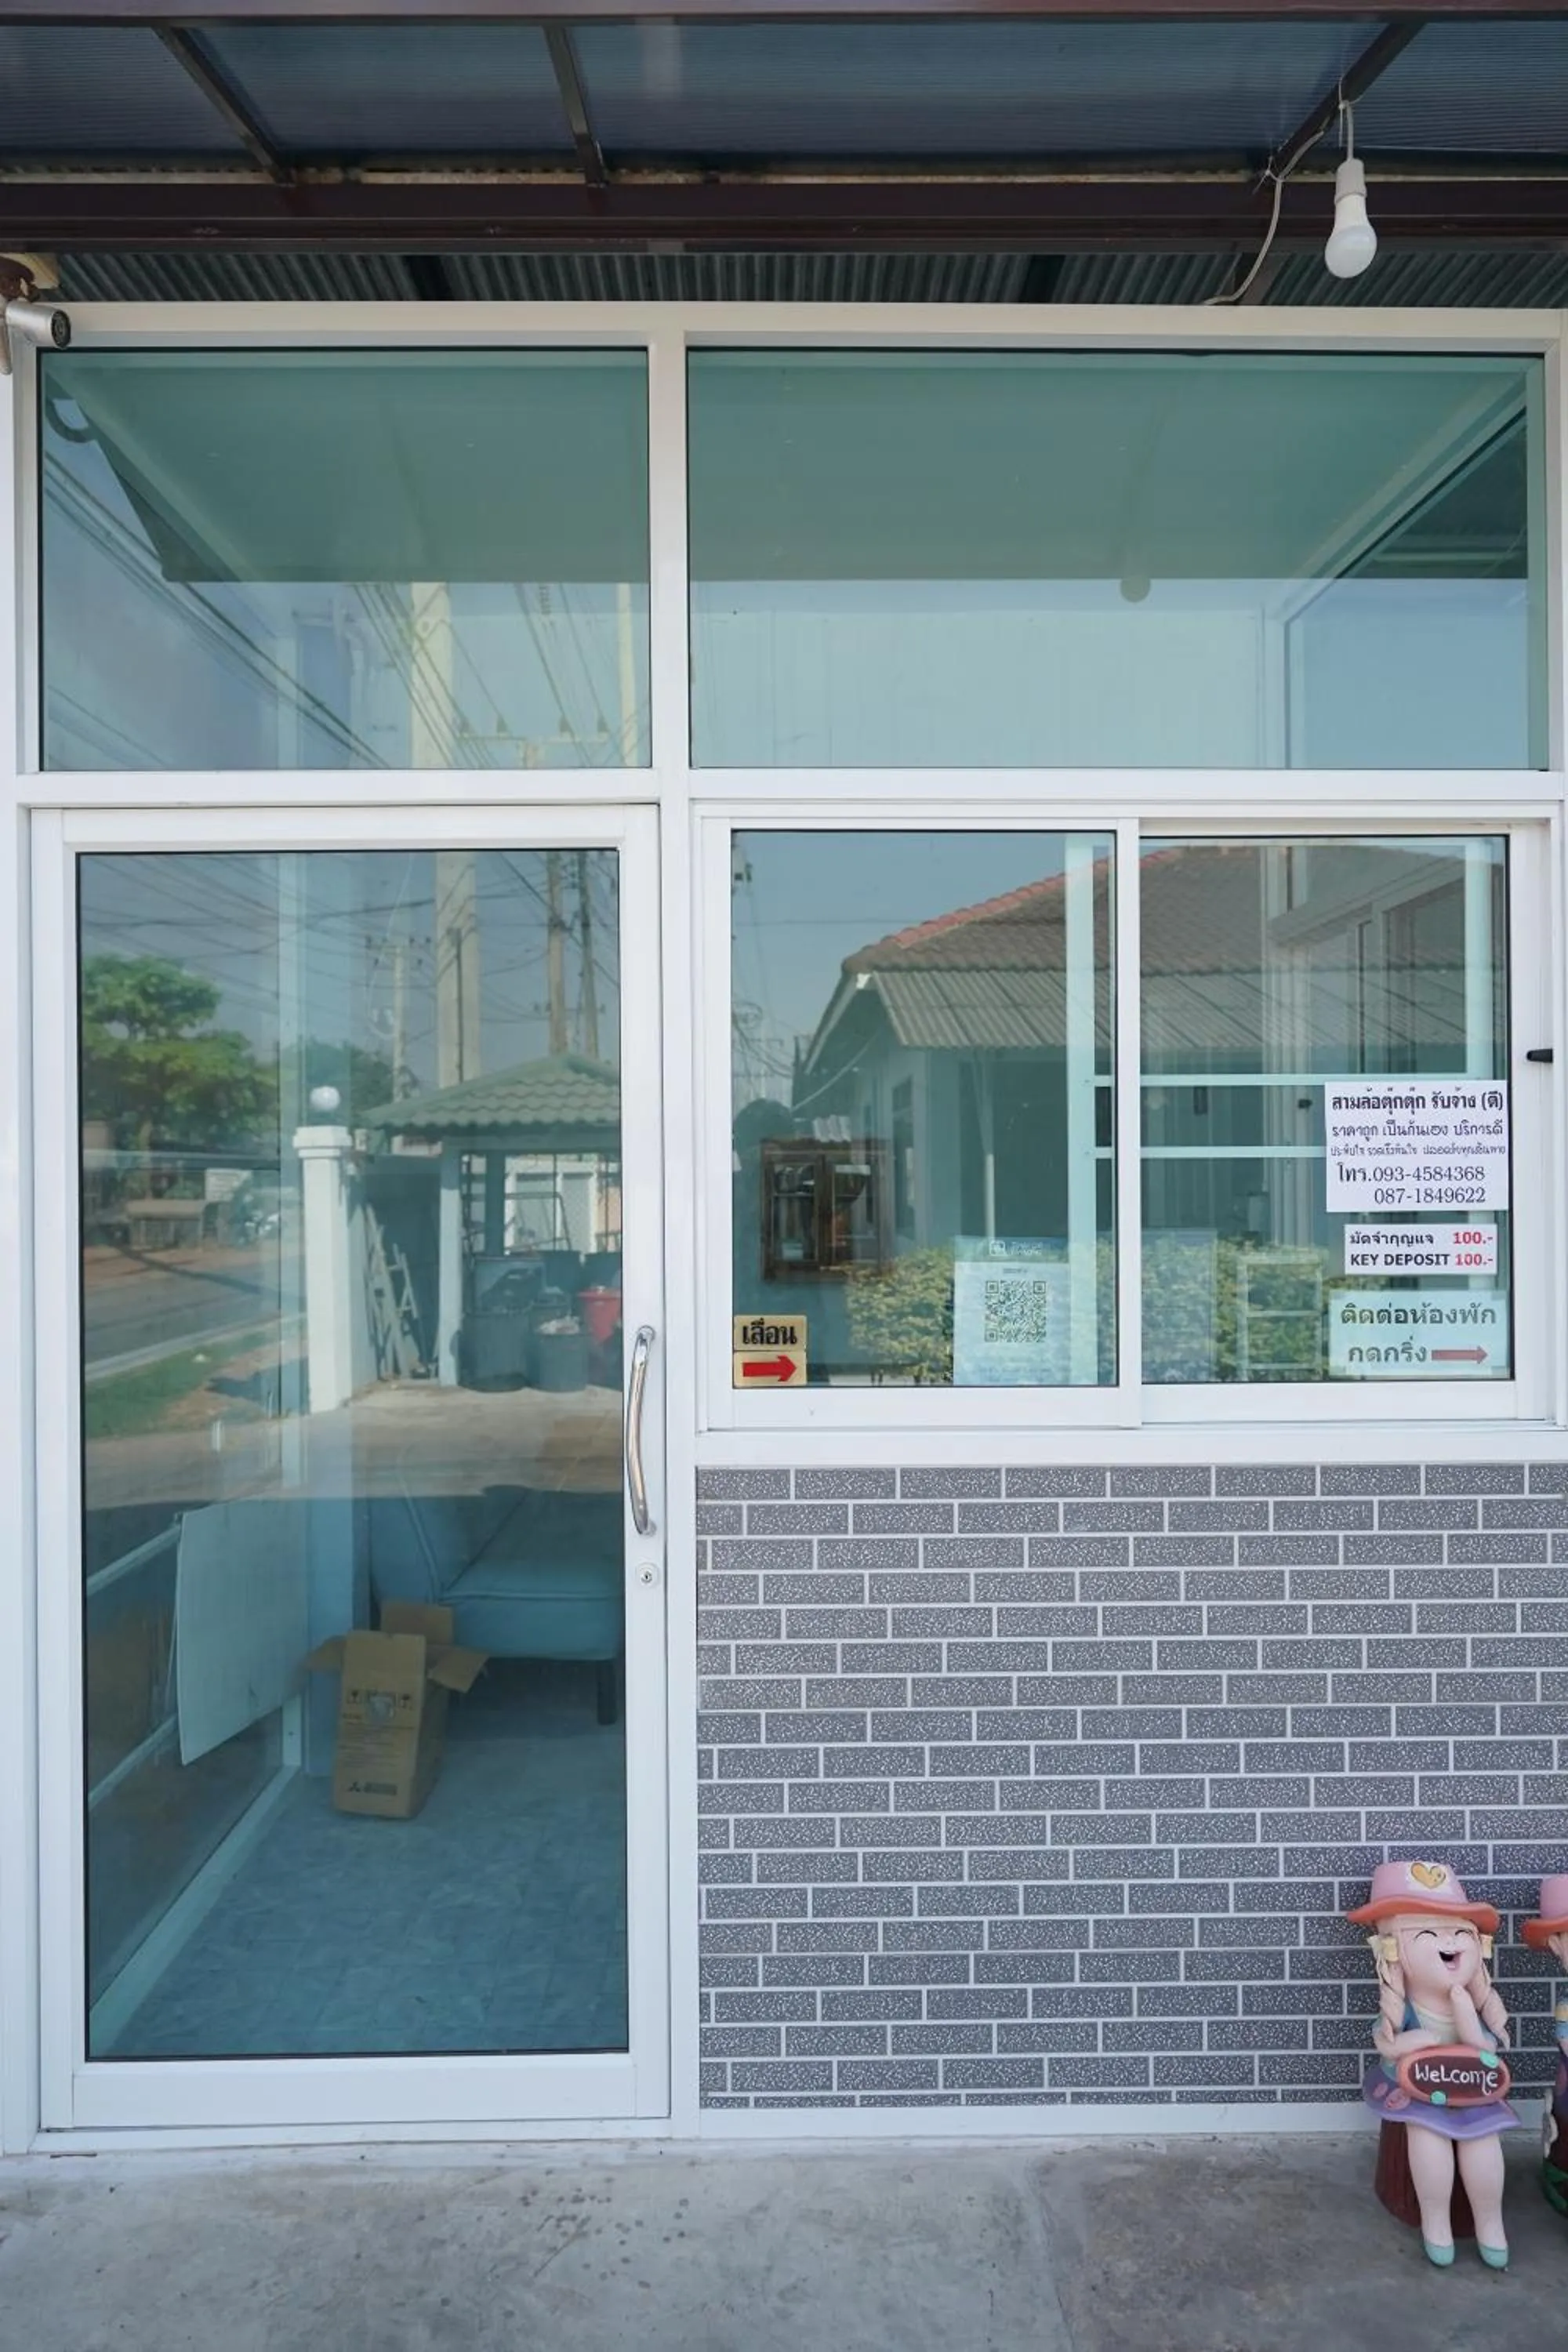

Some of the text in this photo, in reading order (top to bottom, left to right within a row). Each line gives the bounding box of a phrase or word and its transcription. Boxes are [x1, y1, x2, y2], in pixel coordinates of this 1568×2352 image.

[1331, 1087, 1426, 1115] สามล้อตุ๊กตุ๊ก
[1432, 1087, 1476, 1109] รับจ้าง
[1332, 1124, 1379, 1142] ราคาถูก
[1382, 1119, 1448, 1137] เป็นกันเอง
[1337, 1162, 1486, 1182] โทร.093-4584368
[1374, 1187, 1486, 1204] 087-1849622
[1349, 1231, 1494, 1249] มัดจำกุญแจ 100.-
[1350, 1254, 1494, 1266] KEY DEPOSIT 100.-
[1340, 1301, 1496, 1325] ติดต่อห้องพัก
[742, 1317, 797, 1345] เลื่อน
[1348, 1336, 1427, 1363] กดกริ่ง
